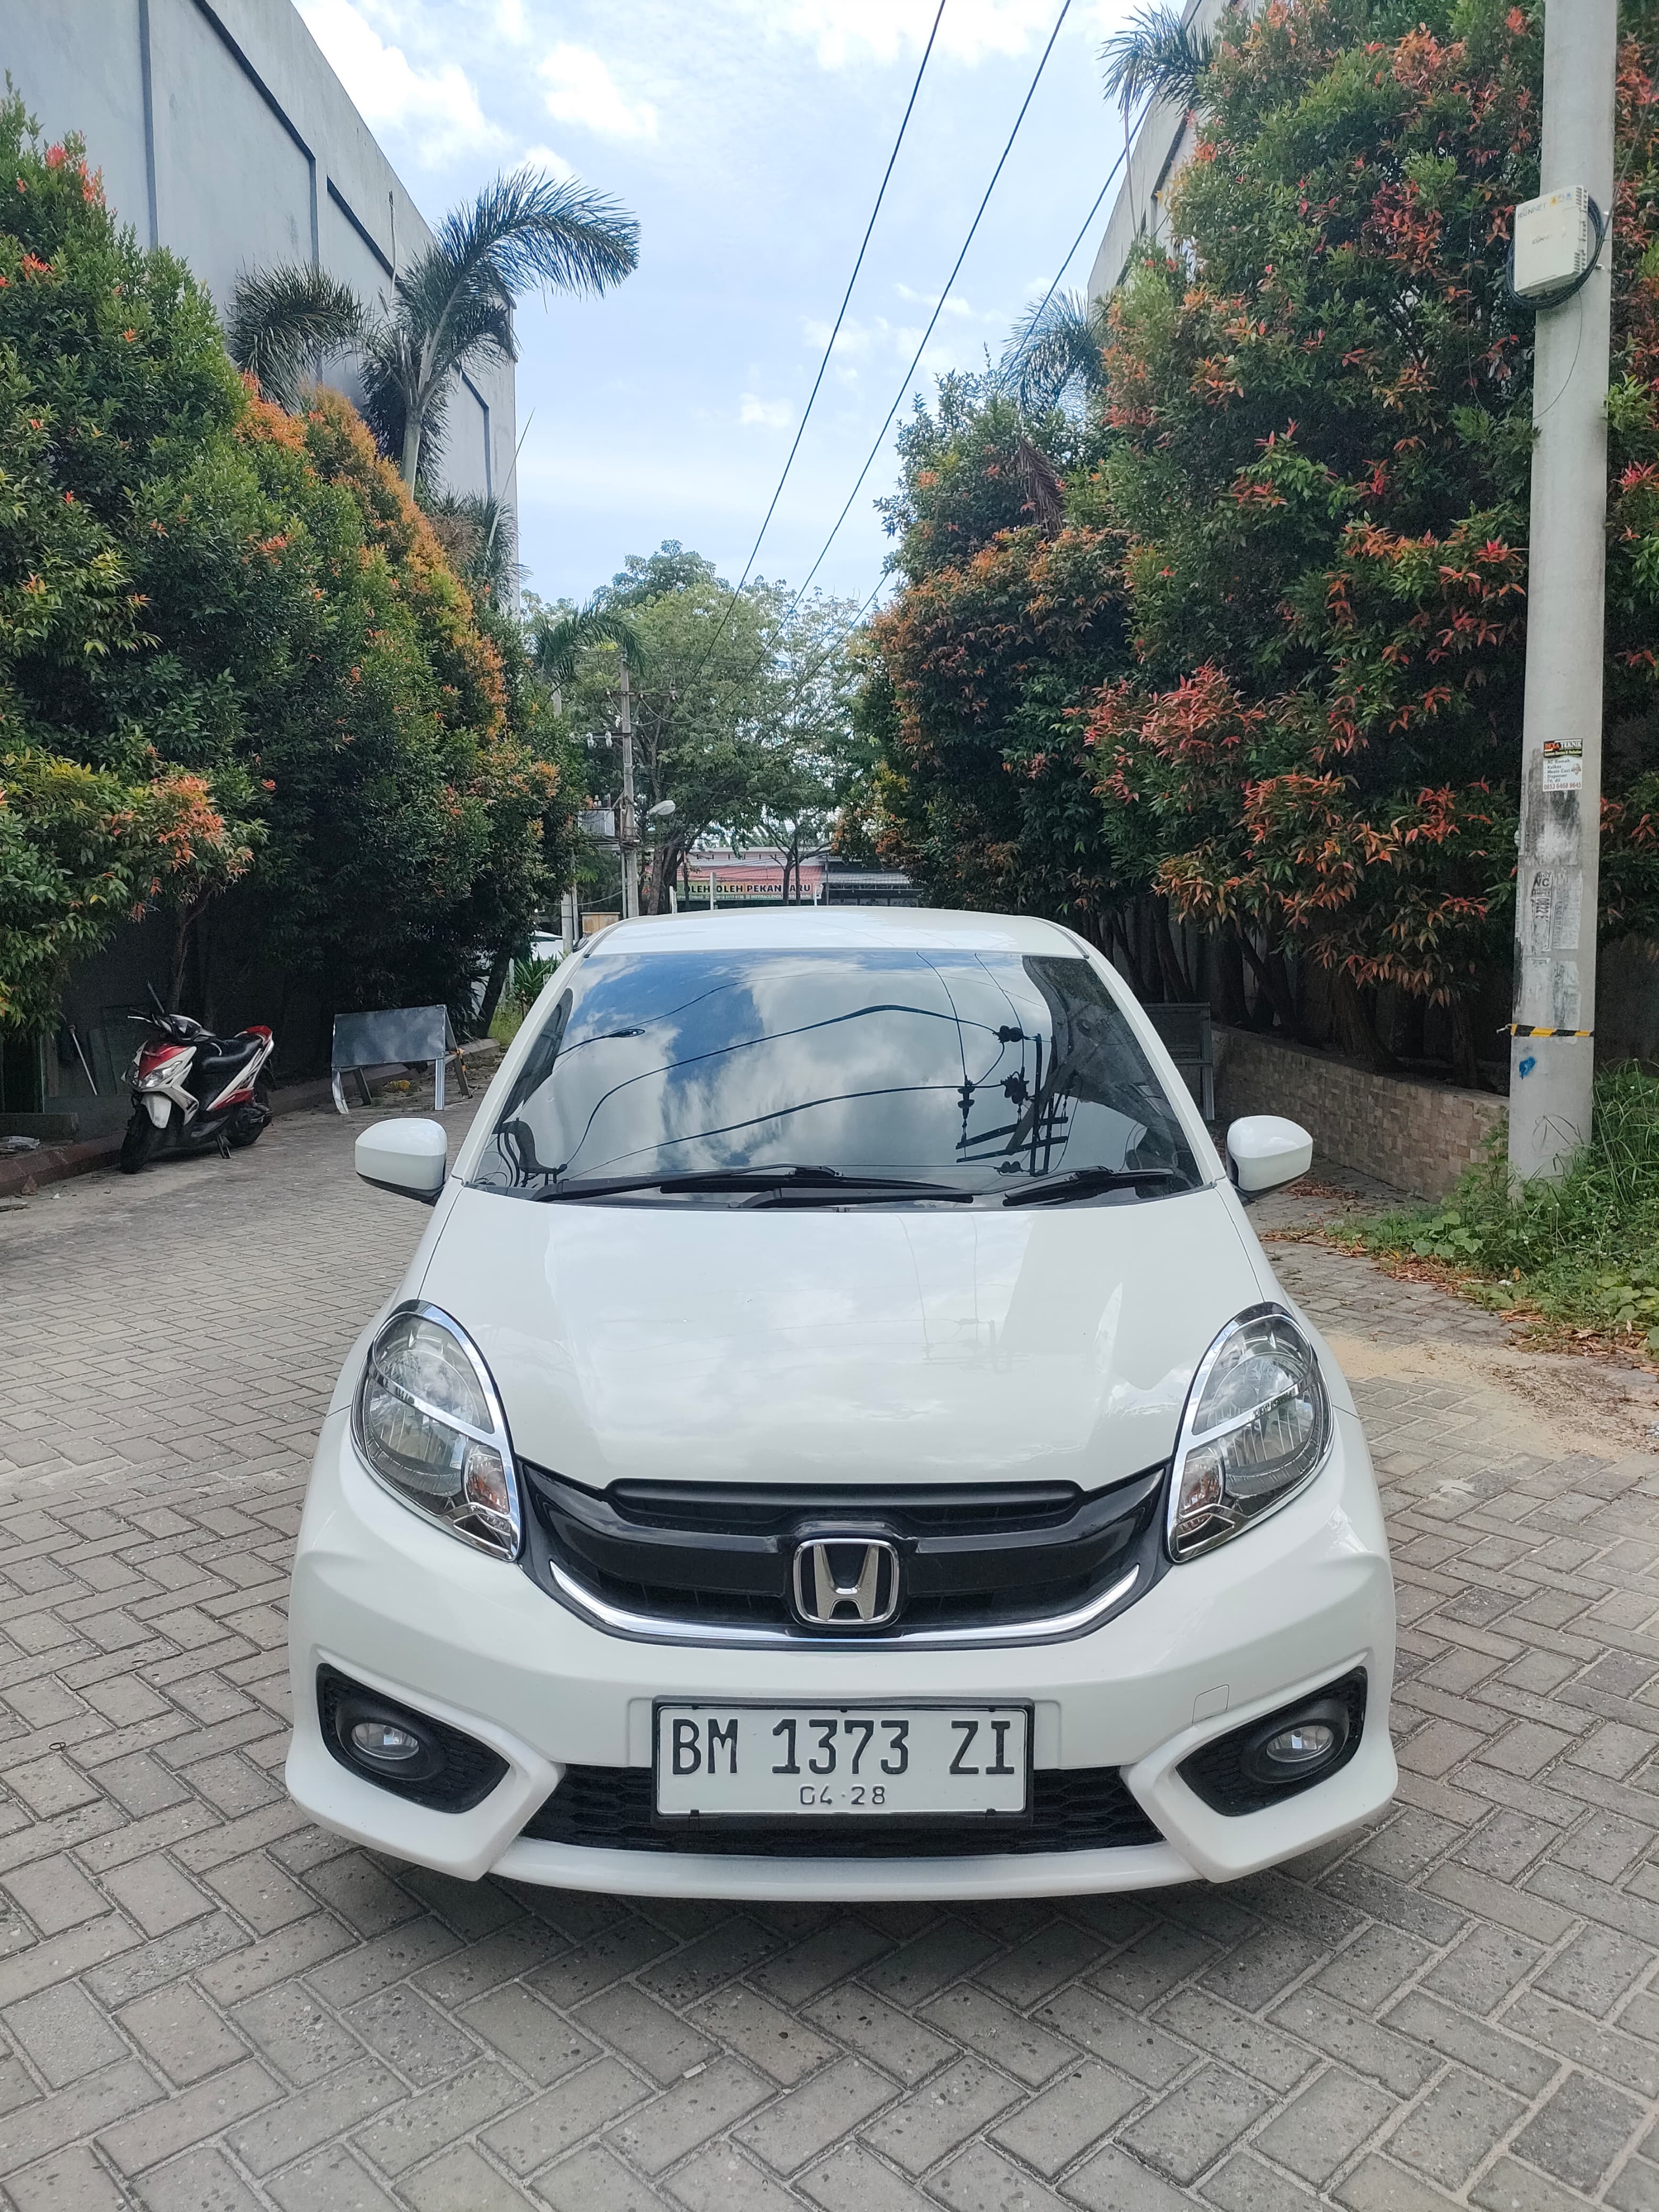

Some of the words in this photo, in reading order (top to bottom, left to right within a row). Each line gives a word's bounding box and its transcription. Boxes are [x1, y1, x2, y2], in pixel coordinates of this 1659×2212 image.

[672, 1719, 738, 1774] BM
[772, 1719, 909, 1775] 1373
[949, 1720, 1015, 1774] ZI
